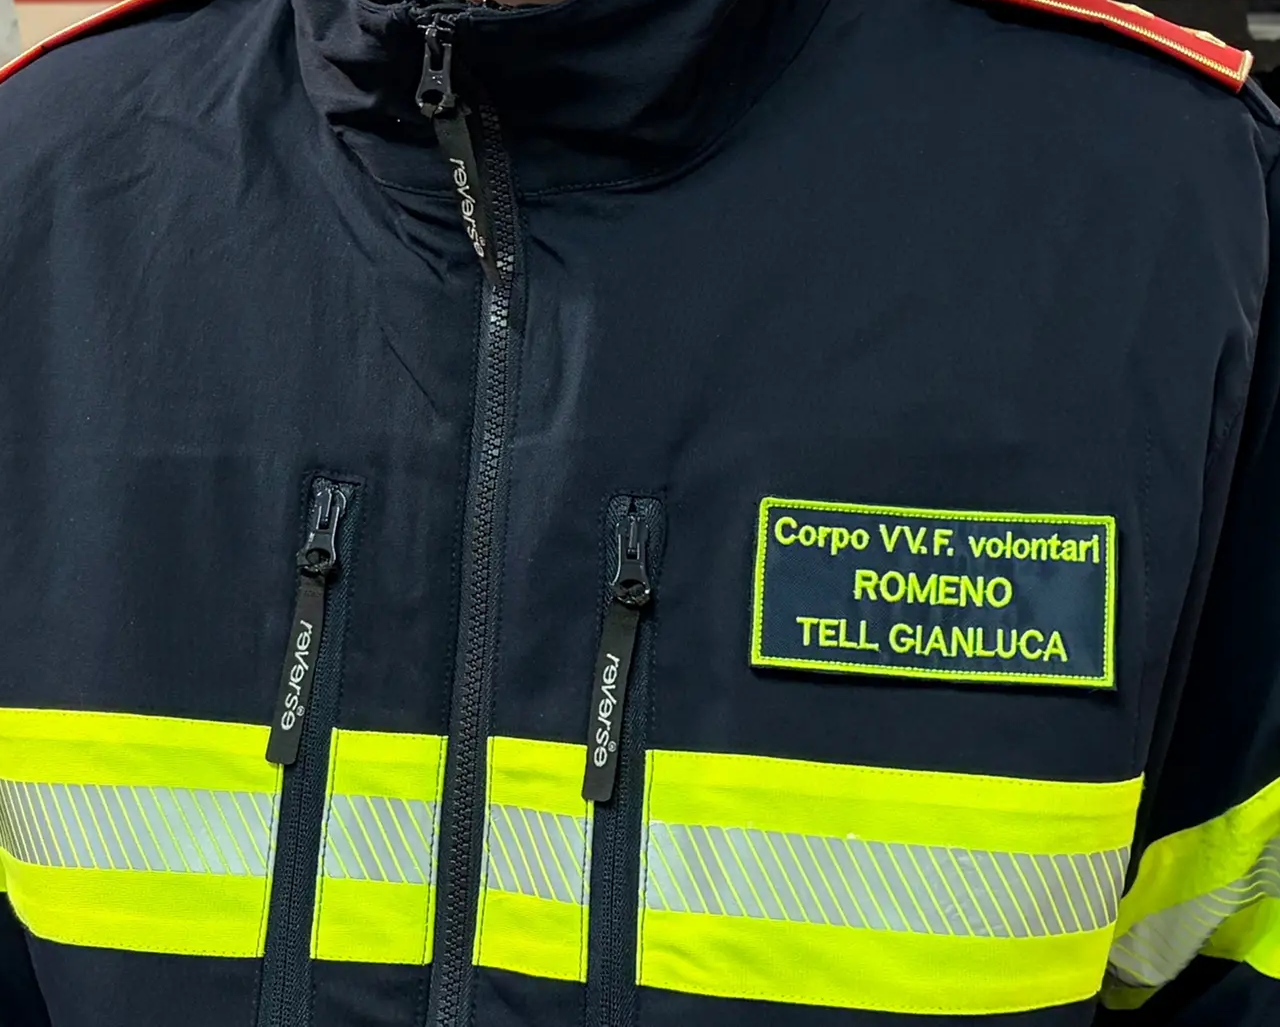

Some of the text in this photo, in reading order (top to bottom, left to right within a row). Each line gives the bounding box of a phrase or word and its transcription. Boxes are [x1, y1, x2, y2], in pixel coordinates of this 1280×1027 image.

[775, 516, 870, 556] Corpo
[969, 531, 1100, 563] volontari
[853, 569, 1013, 608] ROMENO
[796, 616, 1068, 662] TELL GIANLUCA
[281, 619, 313, 731] reverse
[593, 652, 620, 767] reverse
